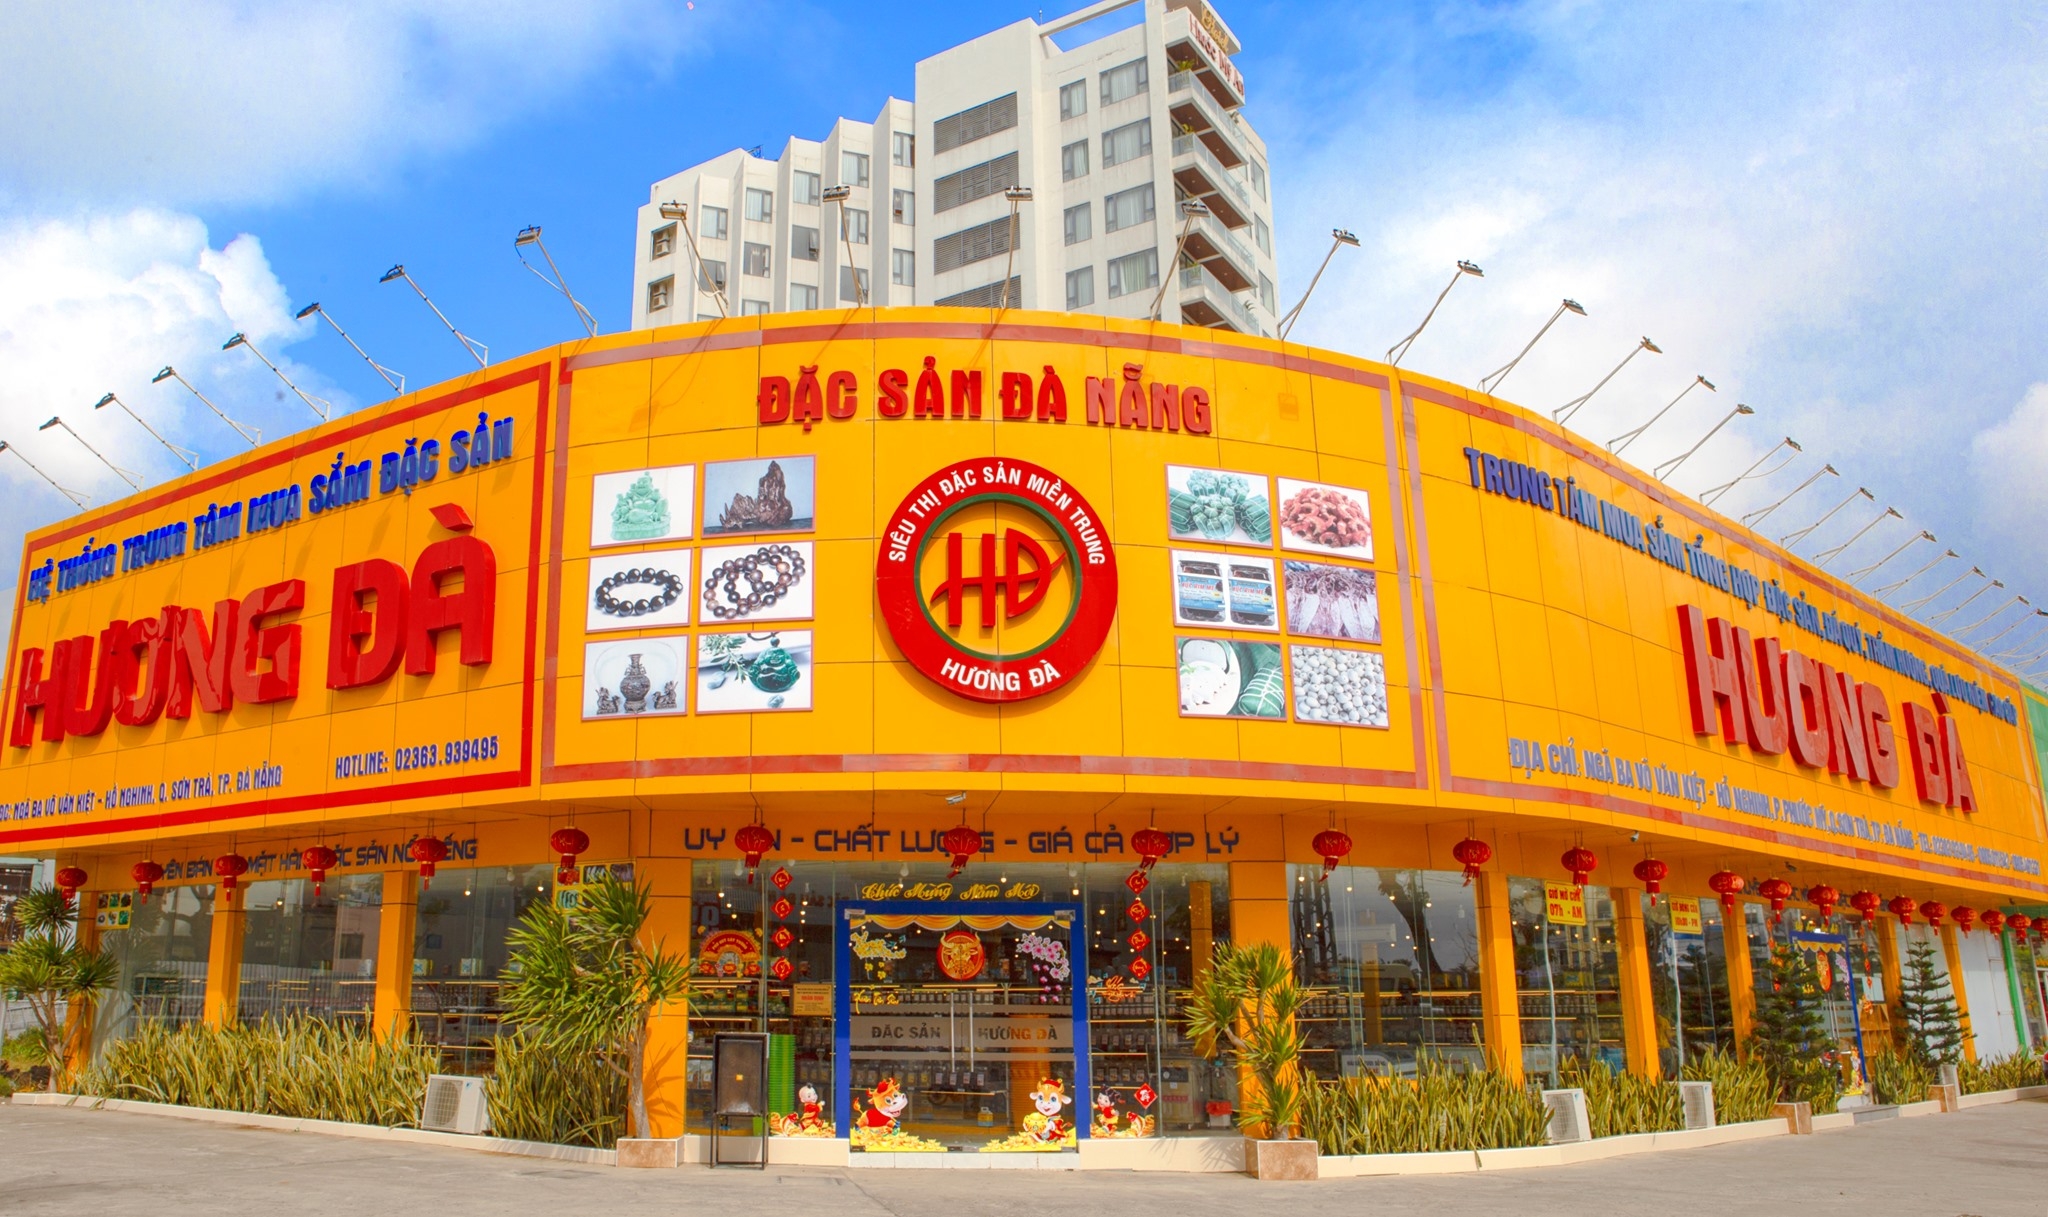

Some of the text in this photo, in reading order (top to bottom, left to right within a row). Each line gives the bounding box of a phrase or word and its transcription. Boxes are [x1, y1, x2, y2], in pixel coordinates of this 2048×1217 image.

[757, 354, 1213, 434] ĐẶC SẢN ĐÀ NẴNG
[122, 522, 188, 573] TRUNG
[194, 503, 242, 550] TÂM
[246, 484, 302, 534] MUA
[308, 451, 372, 514] SẮM
[379, 437, 440, 496] ĐẶC
[448, 412, 514, 474] SẢN
[888, 461, 1106, 564] SIÊU THỊ ĐẶC SẢN MIỀN TRUNG
[1463, 446, 1554, 511] TRUNG
[1552, 476, 1600, 532] TÂM
[1600, 499, 1646, 554] MUA
[1645, 515, 1686, 572] SẮM
[1684, 534, 1730, 593] TỔNG
[1729, 564, 1760, 610] HỢP
[1762, 579, 1793, 624] ĐẶC
[10, 502, 496, 748] HƯƠNG ĐÀ
[940, 658, 1061, 692] HƯƠNG ĐÀ
[1676, 604, 1978, 812] HƯƠNG ĐÀ
[335, 736, 499, 780] HOTLINE: 02363.939495
[1508, 738, 1544, 779] ĐỊA
[1548, 737, 1582, 776] CHỈ:
[1582, 748, 1614, 784] NGÃ
[1614, 758, 1634, 788] BA
[1634, 758, 1652, 792] VÕ
[1654, 762, 1680, 798] VĂN
[1682, 770, 1707, 809] KIỆT
[1714, 775, 1732, 810] HỒ
[13, 798, 30, 820] NGÃ
[32, 800, 43, 818] BA
[44, 794, 57, 817] VÕ
[58, 794, 76, 814] VĂN
[76, 789, 96, 815] KIỆT
[104, 784, 118, 810] HỒ
[171, 776, 191, 800] SƠN
[218, 774, 232, 794] TP.
[236, 766, 250, 792] ĐÀ
[254, 761, 283, 789] NẴNG
[186, 856, 214, 878] BÁN
[356, 840, 388, 866] SẢN
[684, 828, 726, 851] UY
[814, 822, 890, 852] CHẤT
[900, 829, 994, 859] LƯỢG
[1028, 826, 1074, 854] GIÁ
[1085, 824, 1124, 854] CẢ
[1206, 826, 1240, 854] LÝ
[862, 882, 900, 900] Chúc
[904, 882, 954, 900] Mừng
[960, 884, 1000, 900] Năm
[909, 1022, 940, 1038] SẢN
[978, 1025, 1058, 1040] HƯƠNG ĐÀ
